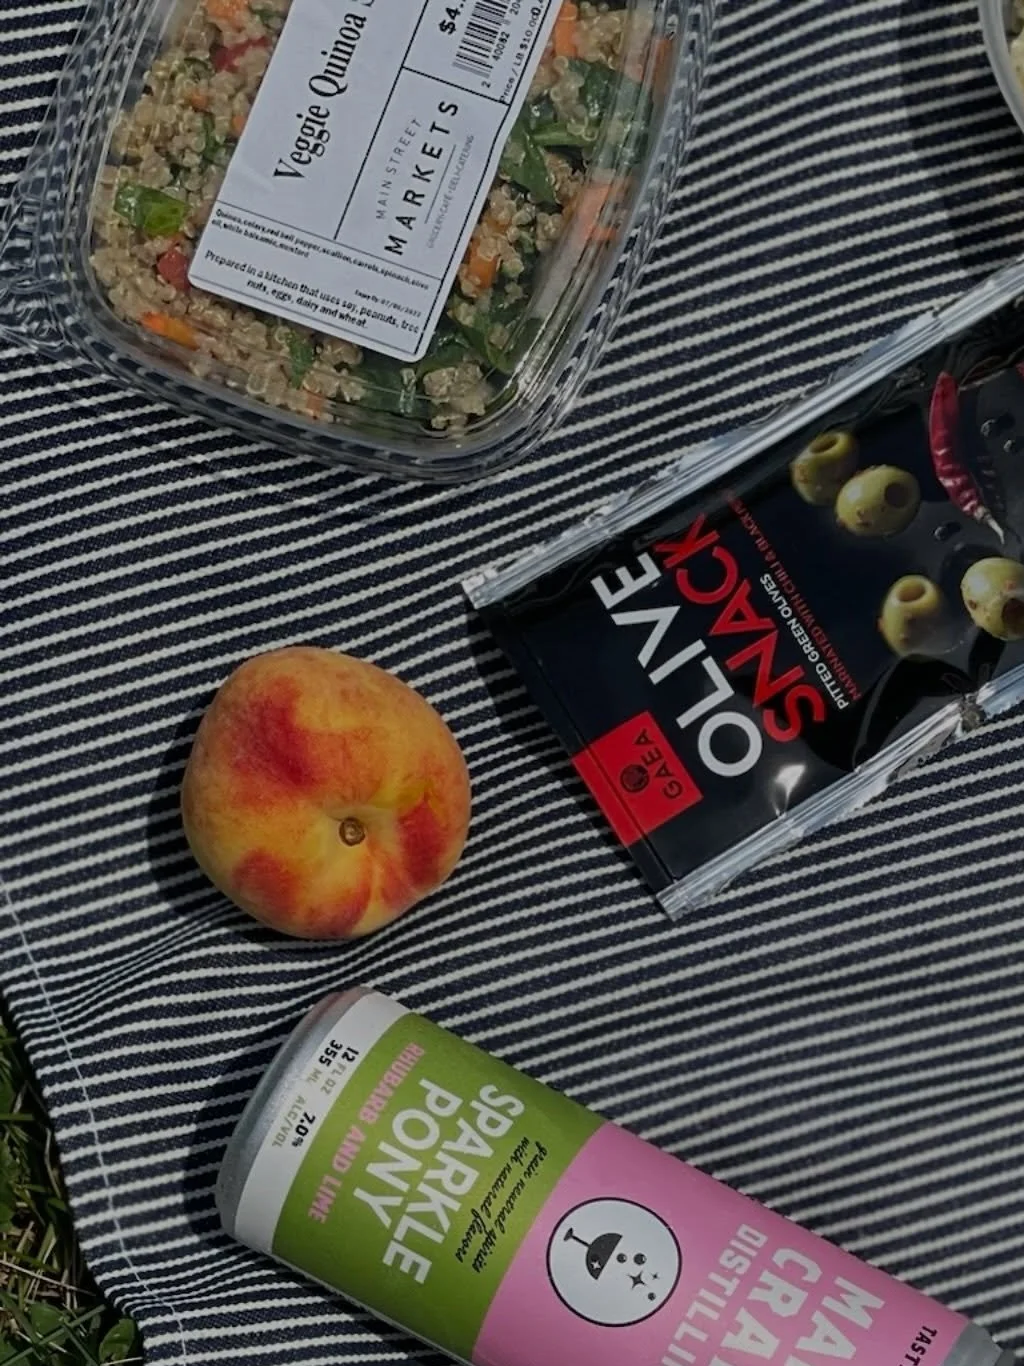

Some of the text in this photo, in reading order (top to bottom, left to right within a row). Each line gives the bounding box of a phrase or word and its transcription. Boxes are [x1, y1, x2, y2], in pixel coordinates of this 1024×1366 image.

[436, 0, 467, 36] $4.
[272, 102, 331, 177] Veggie
[308, 10, 367, 96] Quinoa
[374, 118, 421, 218] MAIN STREET
[383, 98, 459, 256] MARKETS
[203, 248, 247, 273] Prepared
[298, 282, 320, 298] that
[650, 510, 824, 744] SNACK
[768, 560, 797, 596] CHILI
[788, 592, 817, 628] WITH
[588, 548, 762, 778] OLIVE
[757, 571, 850, 710] PITTED GREEN OLIVES
[808, 623, 863, 702] MARINATED
[628, 727, 686, 802] GAEA
[305, 1038, 342, 1086] 355 ML
[320, 1044, 359, 1095] 12 FL OZ
[291, 1111, 315, 1149] 7.0%
[306, 1040, 425, 1224] RHUBARB AND LIME
[350, 1077, 462, 1229] PONY
[380, 1081, 526, 1284] SPARKLE
[453, 1136, 532, 1263] with natural flavors
[470, 1140, 549, 1273] grain neutral spirits
